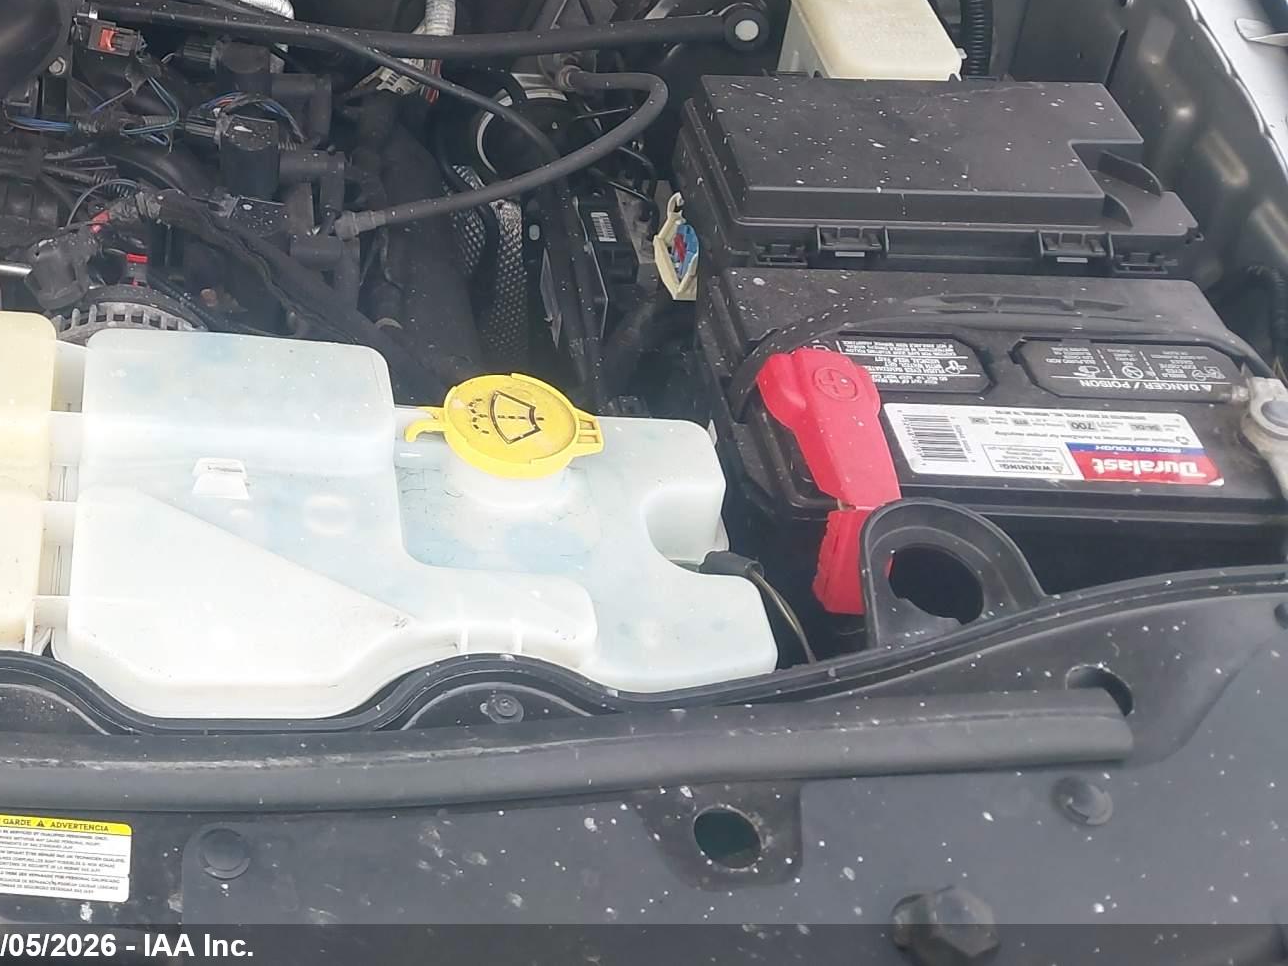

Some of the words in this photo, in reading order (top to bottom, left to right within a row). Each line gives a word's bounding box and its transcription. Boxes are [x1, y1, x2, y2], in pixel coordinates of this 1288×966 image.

[1080, 379, 1131, 389] POISON
[1145, 382, 1201, 392] DANGER
[1071, 421, 1094, 430] 700
[1095, 445, 1133, 453] TOUGH
[1135, 445, 1182, 454] PROVEN
[999, 463, 1051, 472] WARNING:
[1092, 457, 1207, 478] Duralast
[2, 818, 32, 827] GARDE
[49, 821, 110, 832] ADVERTENCIA
